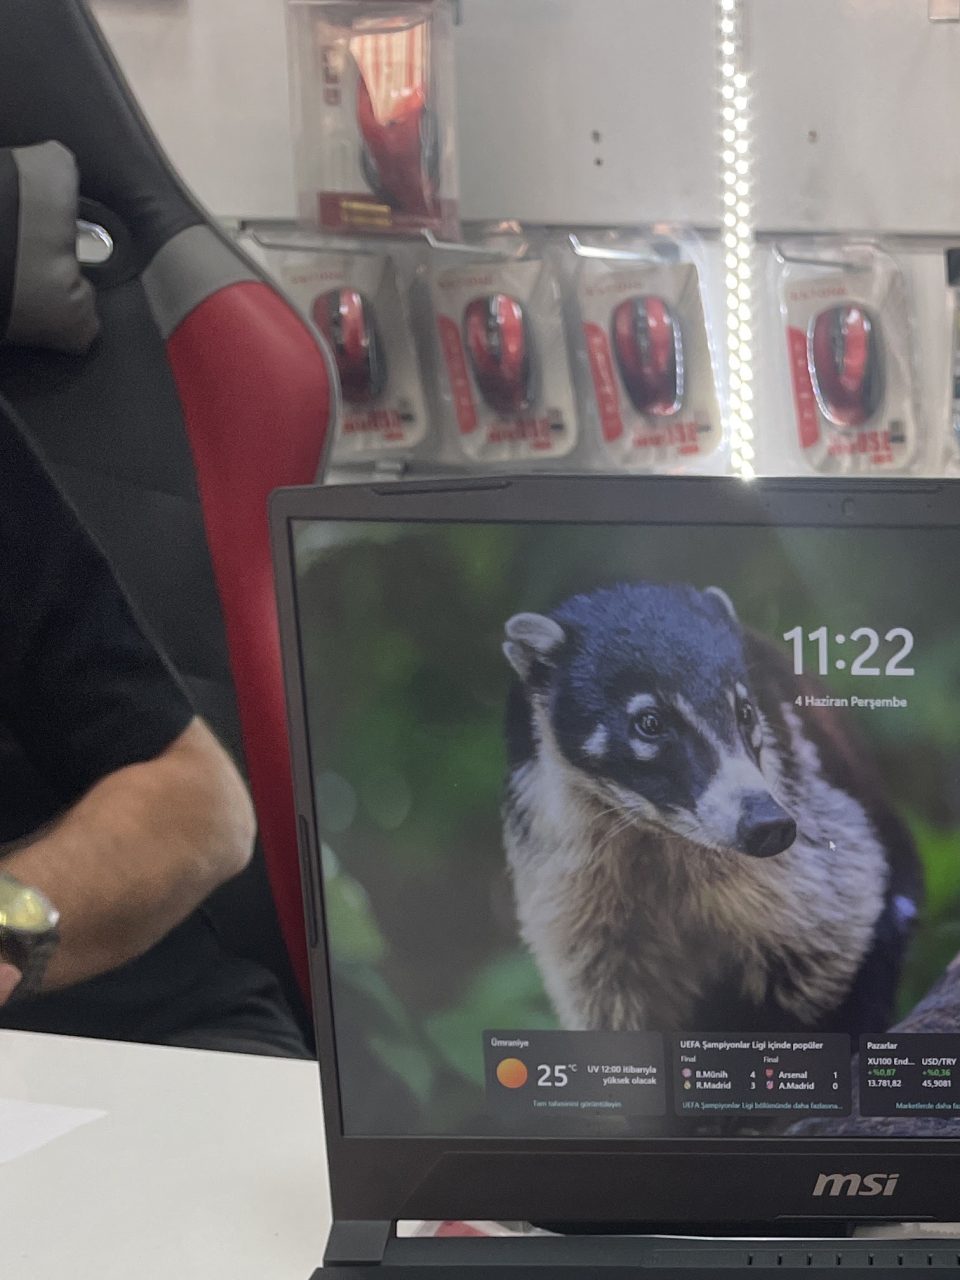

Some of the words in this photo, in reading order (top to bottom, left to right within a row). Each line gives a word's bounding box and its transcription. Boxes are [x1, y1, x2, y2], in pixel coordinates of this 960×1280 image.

[783, 626, 915, 676] 11:22
[795, 696, 802, 706] 4
[805, 696, 848, 707] Haziran
[851, 696, 907, 709] Perşembe
[491, 1037, 529, 1048] Ümraniye
[680, 1041, 700, 1049] UEFA
[702, 1041, 750, 1051] Şampiyonlar
[752, 1041, 766, 1051] Ligi
[767, 1041, 791, 1051] içinde
[793, 1042, 824, 1051] popüler
[867, 1042, 898, 1050] Pazarlar
[868, 1057, 892, 1066] XU100
[922, 1057, 957, 1067] USD/TRY
[537, 1064, 568, 1087] 25
[696, 1070, 728, 1079] B.Münih
[750, 1071, 756, 1079] 4
[778, 1071, 808, 1079] Arsenal
[602, 1077, 629, 1086] yüksek
[632, 1077, 657, 1085] olacak
[696, 1081, 731, 1089] R.Madrid
[778, 1082, 815, 1090] A.Madrid
[868, 1079, 901, 1088] 13.781,82
[922, 1079, 951, 1088] 45,9081
[812, 1173, 900, 1196] msi
